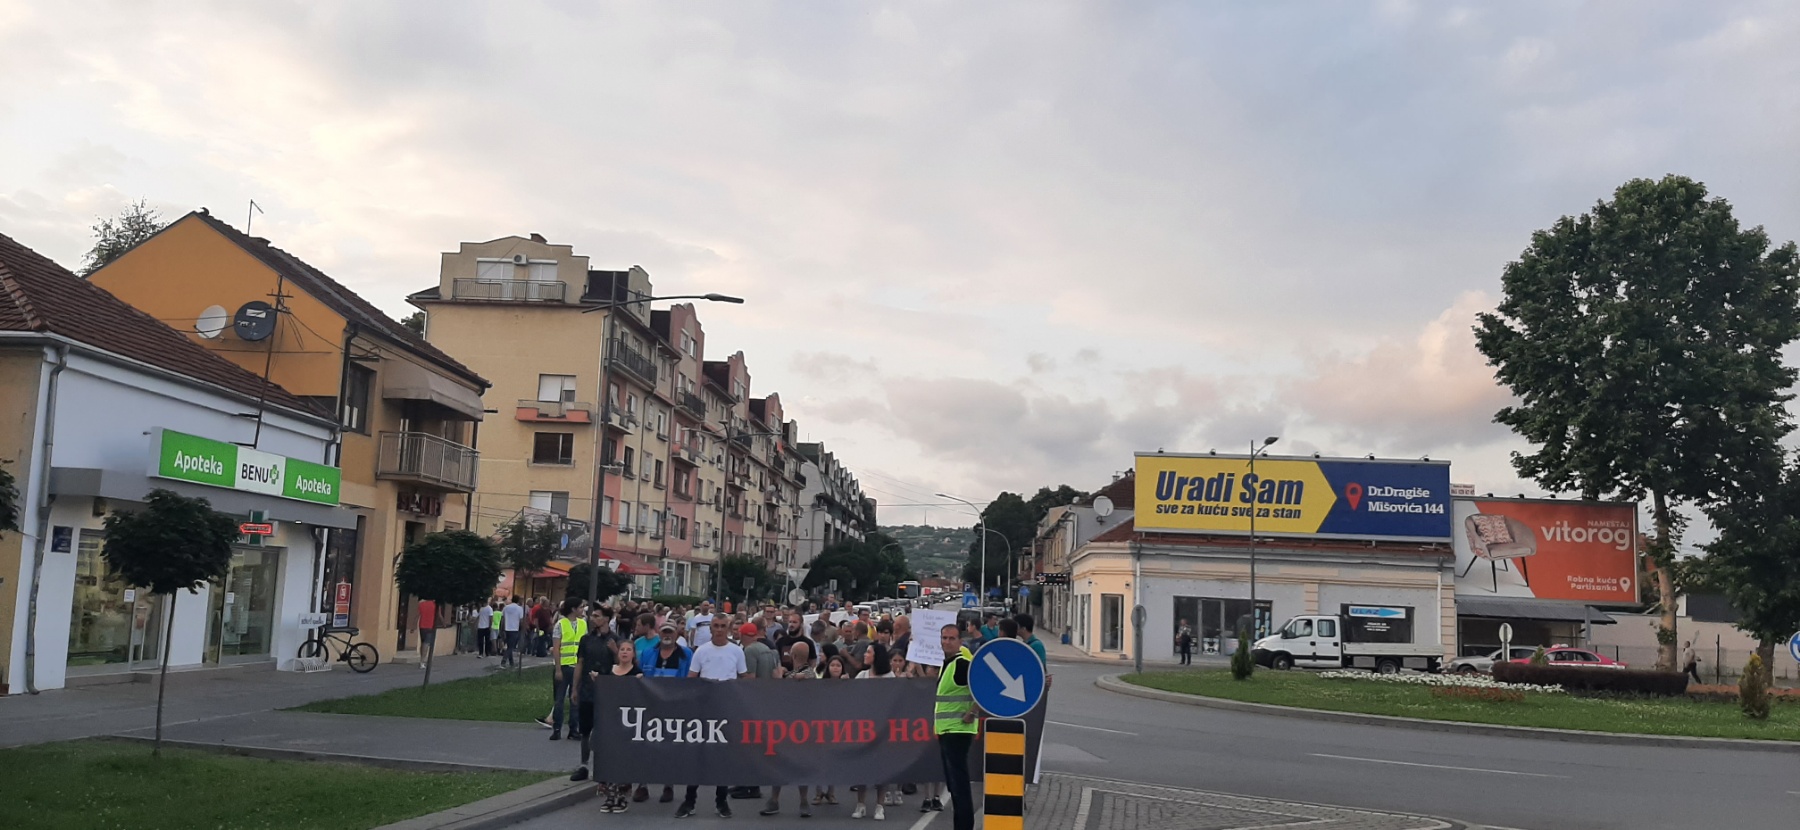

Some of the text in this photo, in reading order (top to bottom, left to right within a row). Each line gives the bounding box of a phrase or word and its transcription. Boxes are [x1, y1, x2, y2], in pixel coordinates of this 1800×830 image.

[174, 450, 223, 475] Apoteka
[241, 464, 269, 483] BENU
[295, 474, 332, 495] Apoteka
[1155, 470, 1304, 505] Uradi Sam
[1368, 486, 1430, 499] Dr.Dragiše
[1156, 503, 1302, 519] sve za kuću sve za stan
[1368, 501, 1445, 514] Mišovića 144
[1541, 520, 1630, 550] vitorog
[964, 583, 971, 591] P
[1567, 575, 1617, 585] Robna kuća
[1571, 583, 1617, 591] Partizanka
[619, 706, 728, 743] Чачак
[740, 718, 877, 756] против
